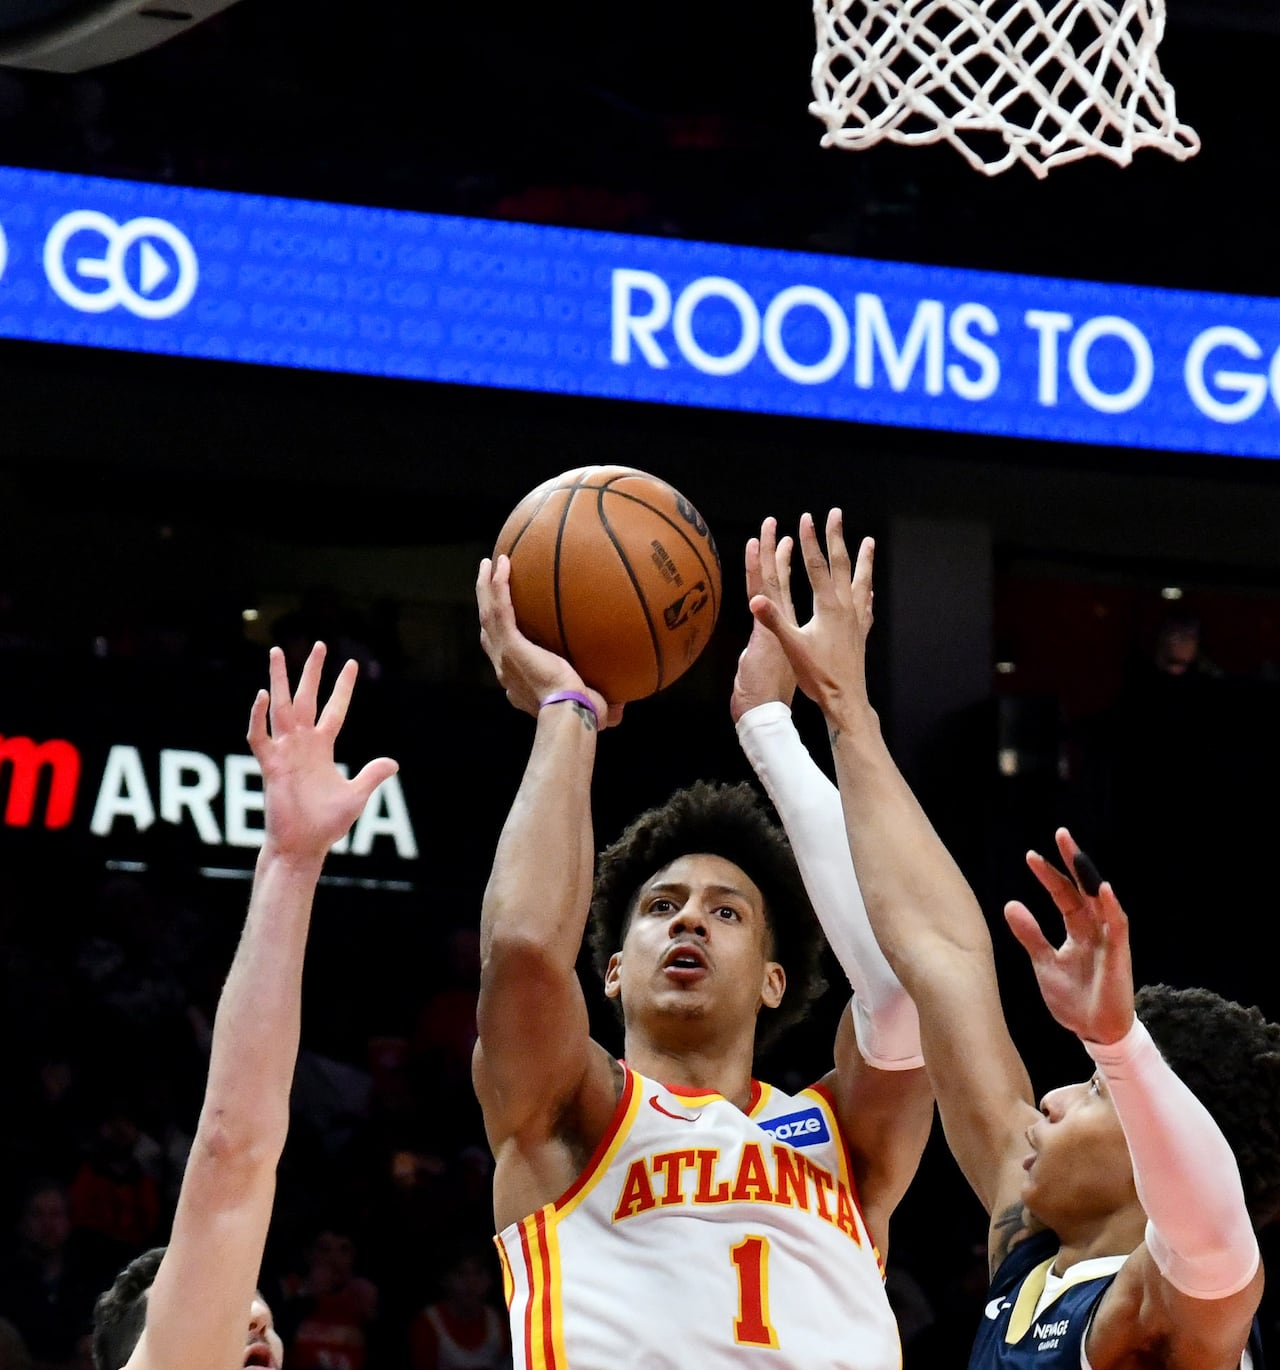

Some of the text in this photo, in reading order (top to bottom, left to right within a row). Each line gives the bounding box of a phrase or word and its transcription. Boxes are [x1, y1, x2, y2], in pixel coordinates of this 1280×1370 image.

[45, 211, 197, 318] GO
[613, 270, 998, 399] ROOMS
[1026, 311, 1152, 412] TO
[90, 744, 419, 860] AREA
[611, 1142, 862, 1249] ATLANTA
[729, 1234, 780, 1349] 1
